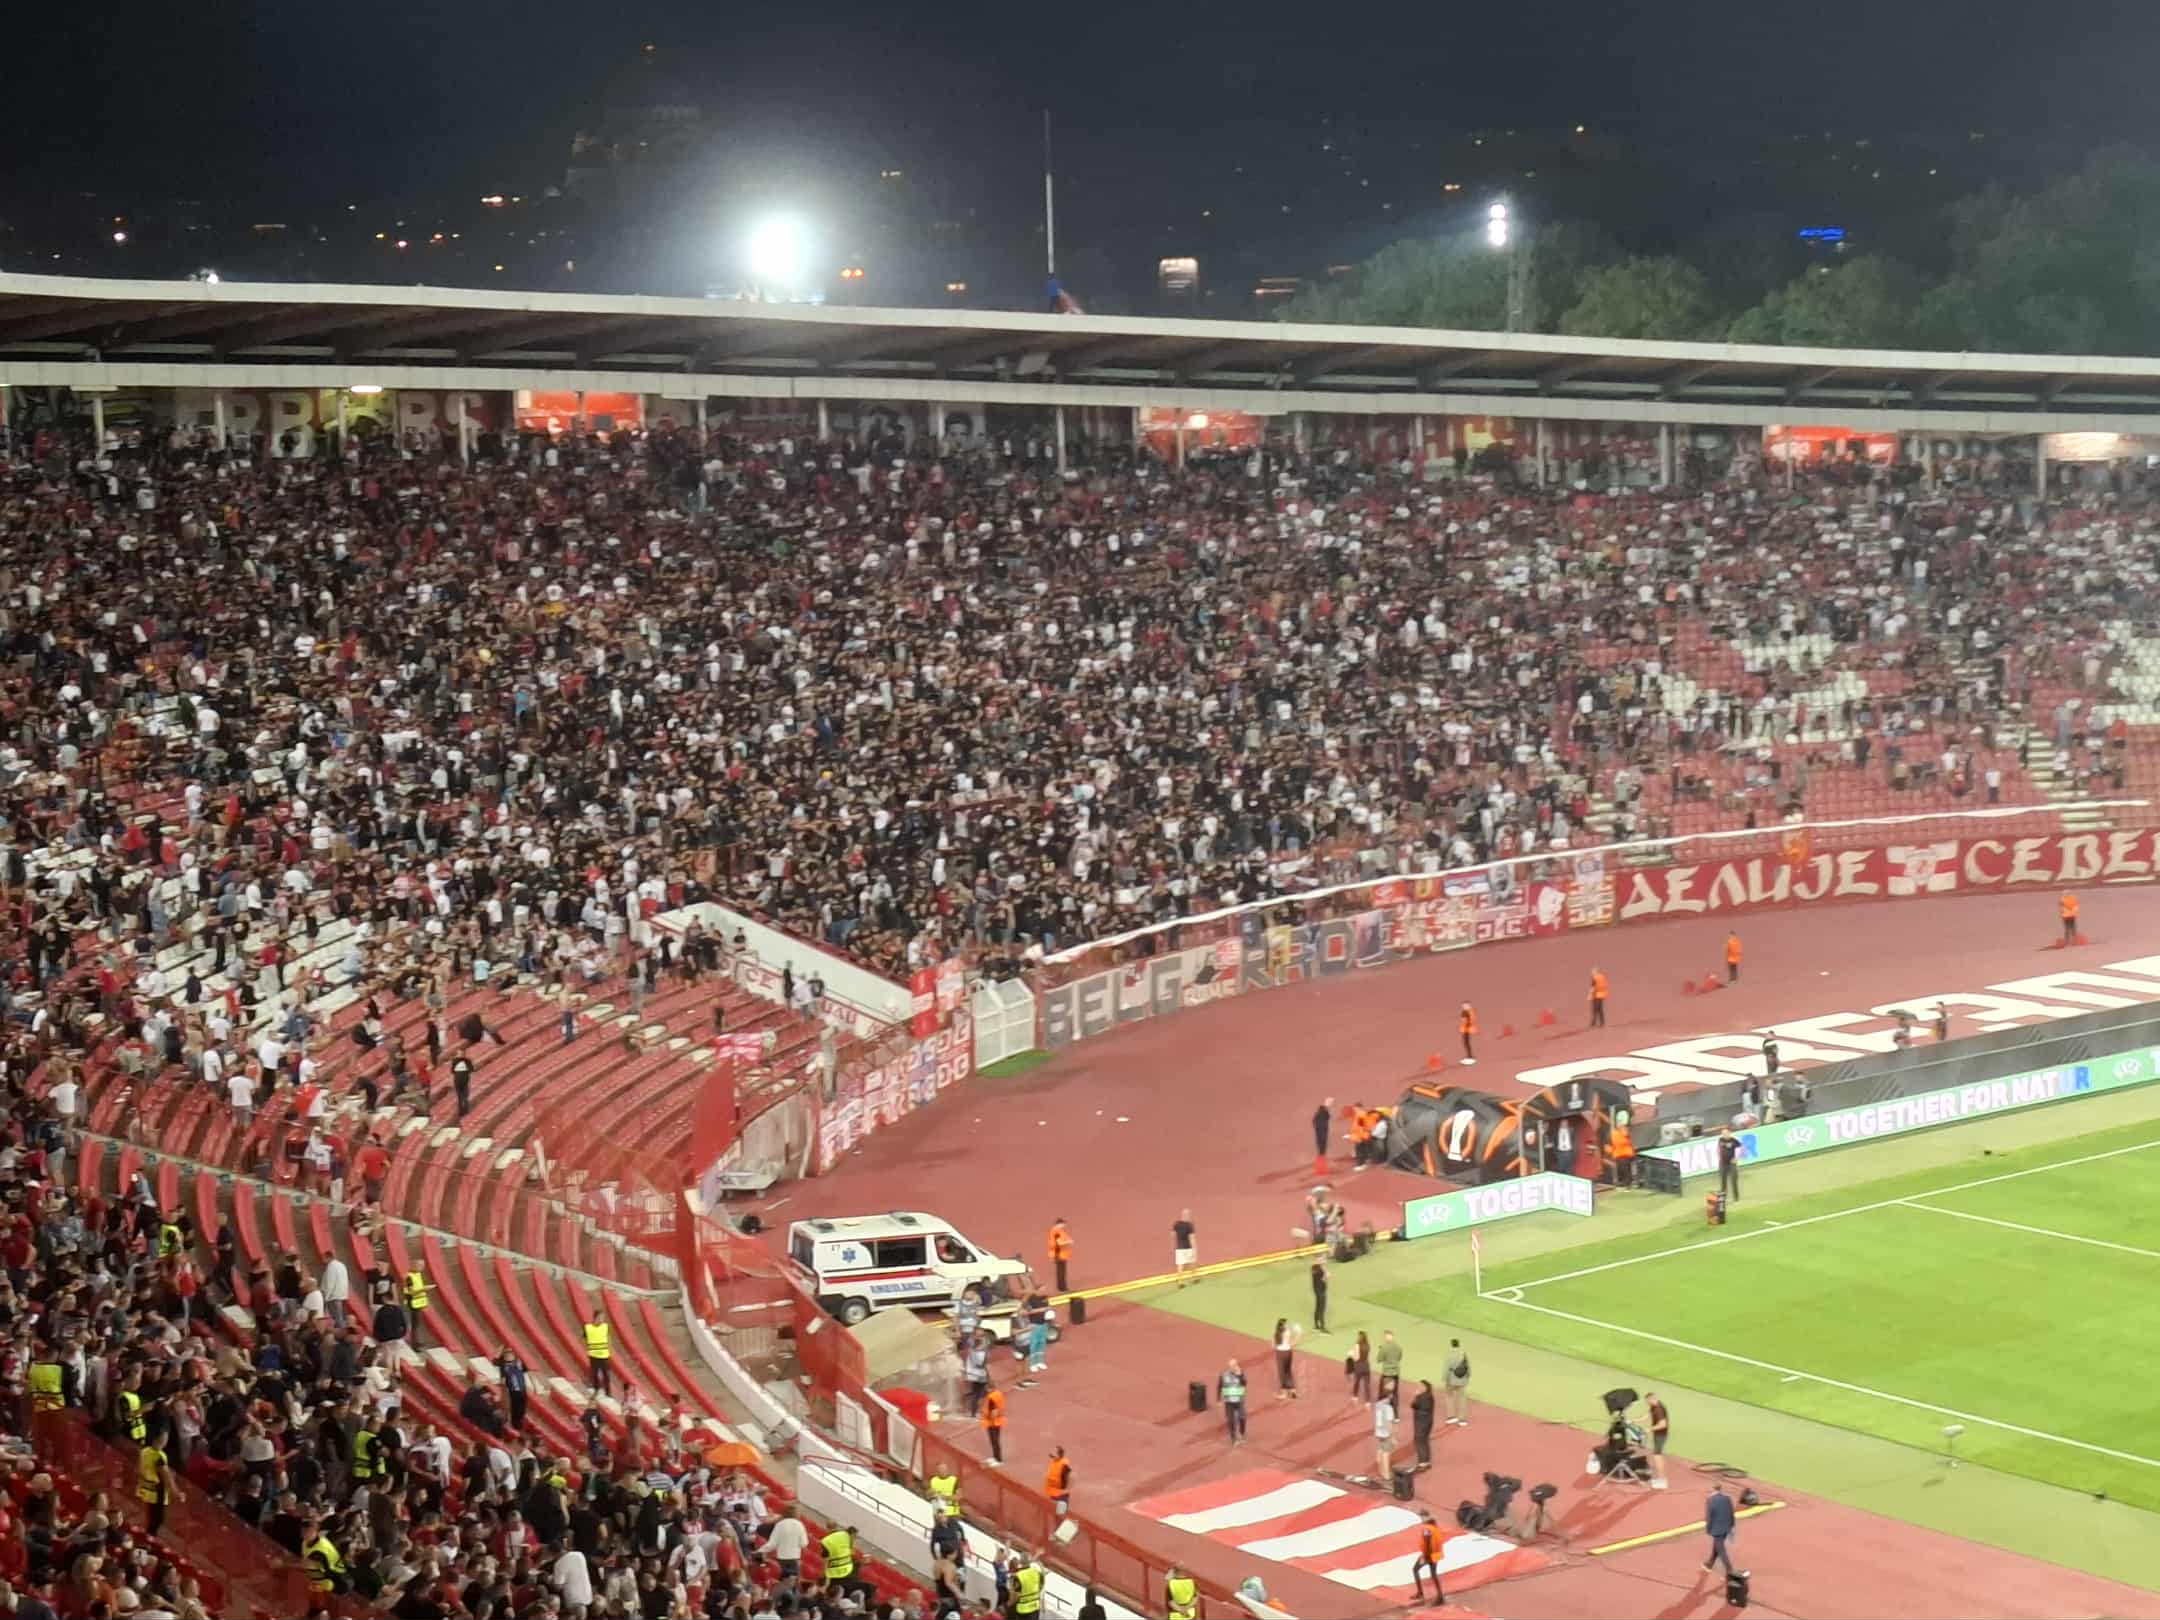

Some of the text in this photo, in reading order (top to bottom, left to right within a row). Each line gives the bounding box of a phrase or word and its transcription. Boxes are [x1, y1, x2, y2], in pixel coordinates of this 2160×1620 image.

[1825, 1093, 1960, 1142] TOGETHER
[1960, 1081, 2010, 1116] FOR
[1464, 1176, 1591, 1221] TOGETHE
